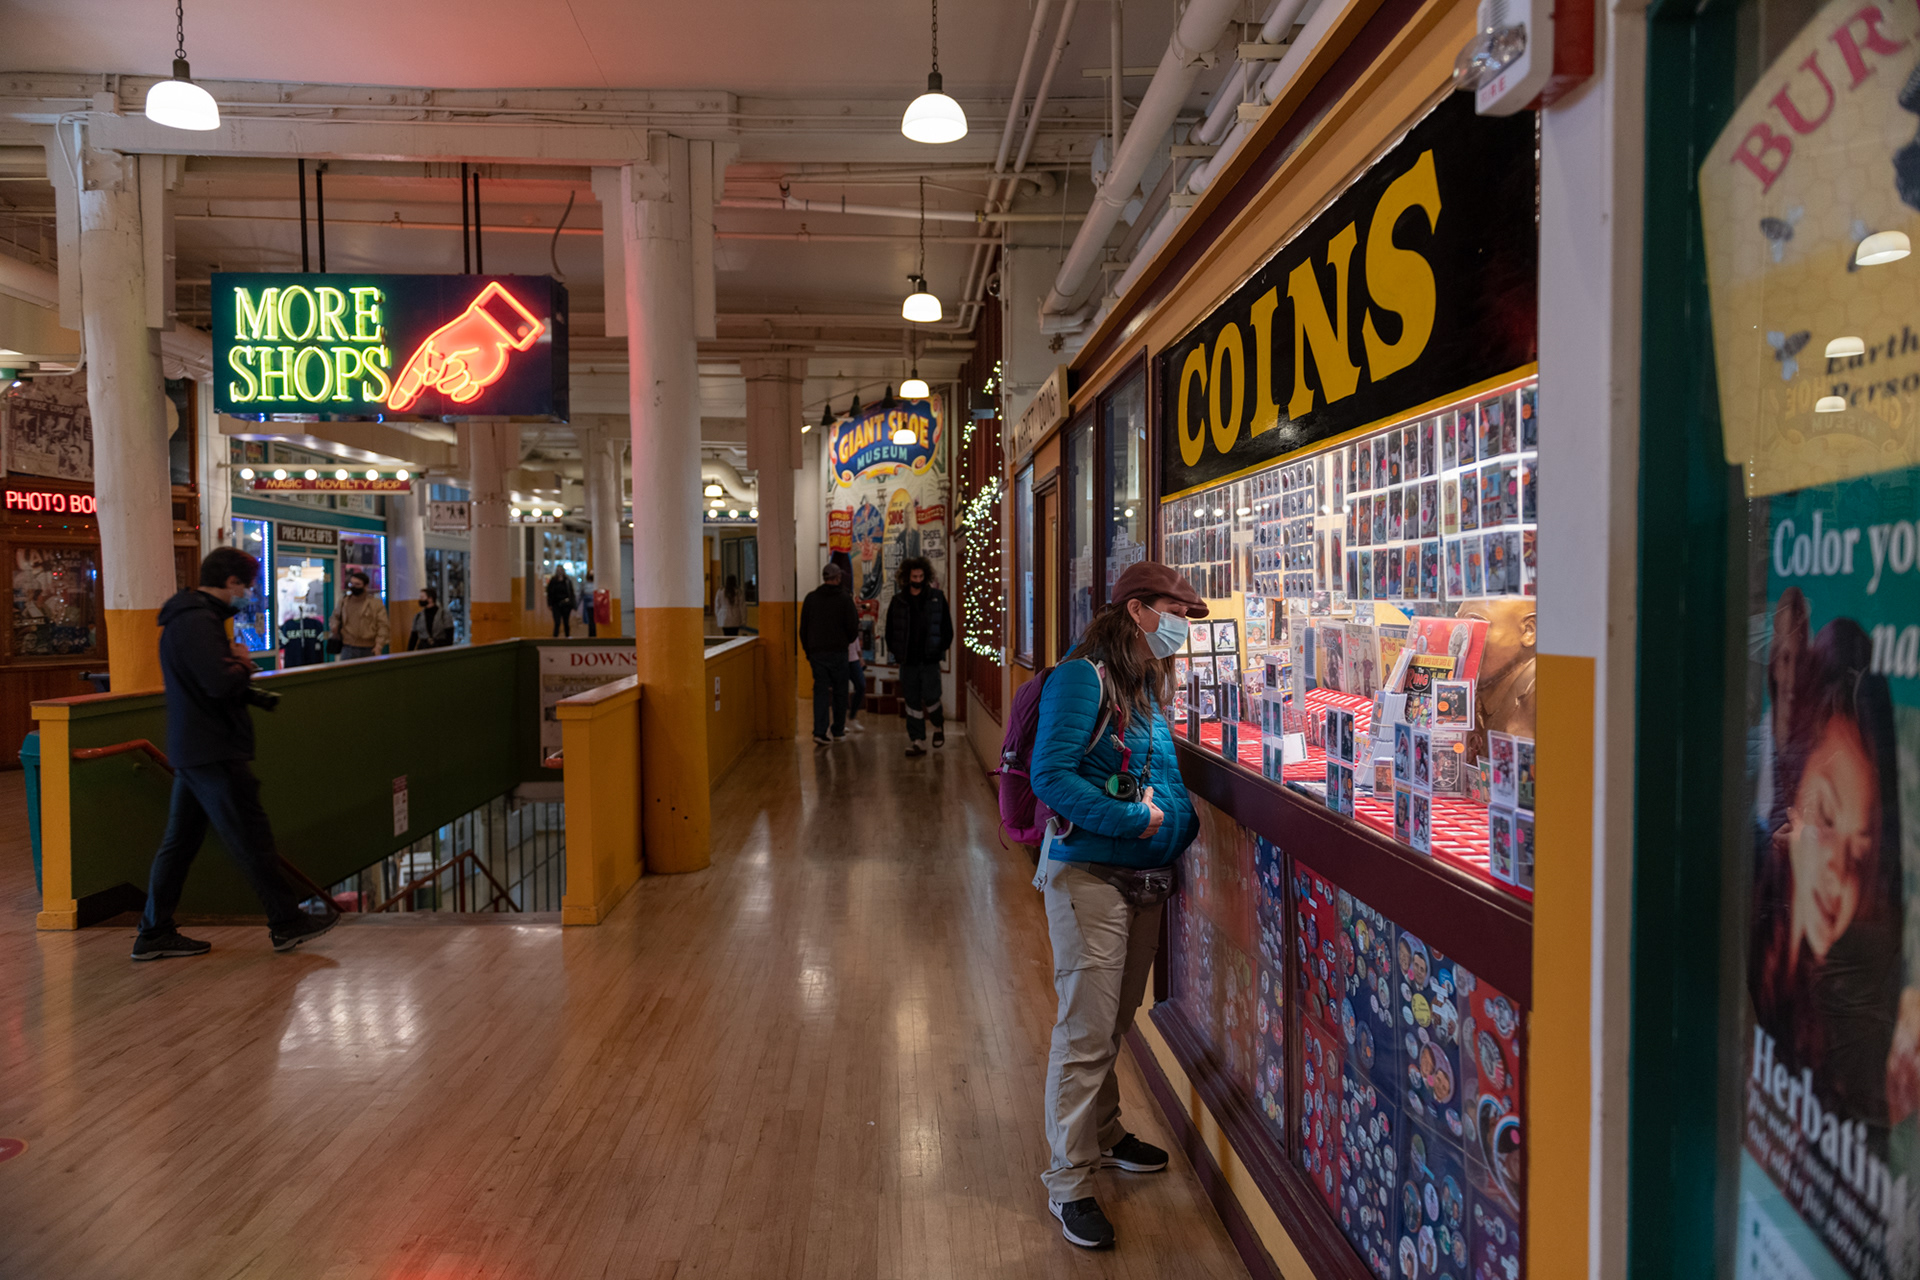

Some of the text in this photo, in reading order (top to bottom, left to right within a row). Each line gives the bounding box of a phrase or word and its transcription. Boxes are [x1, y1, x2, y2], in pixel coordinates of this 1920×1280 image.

[233, 285, 386, 342] MORE
[1178, 149, 1442, 467] COINS
[228, 345, 392, 403] SHOPS
[838, 413, 886, 464] GIANT
[856, 446, 909, 470] MUSEUM
[5, 490, 66, 512] PHOTO
[266, 479, 401, 489] MAGIC NOVELTY SHOP
[298, 527, 316, 543] PLACE
[316, 529, 333, 544] GIFTS
[1773, 511, 1861, 578] Color
[1405, 669, 1429, 689] RING
